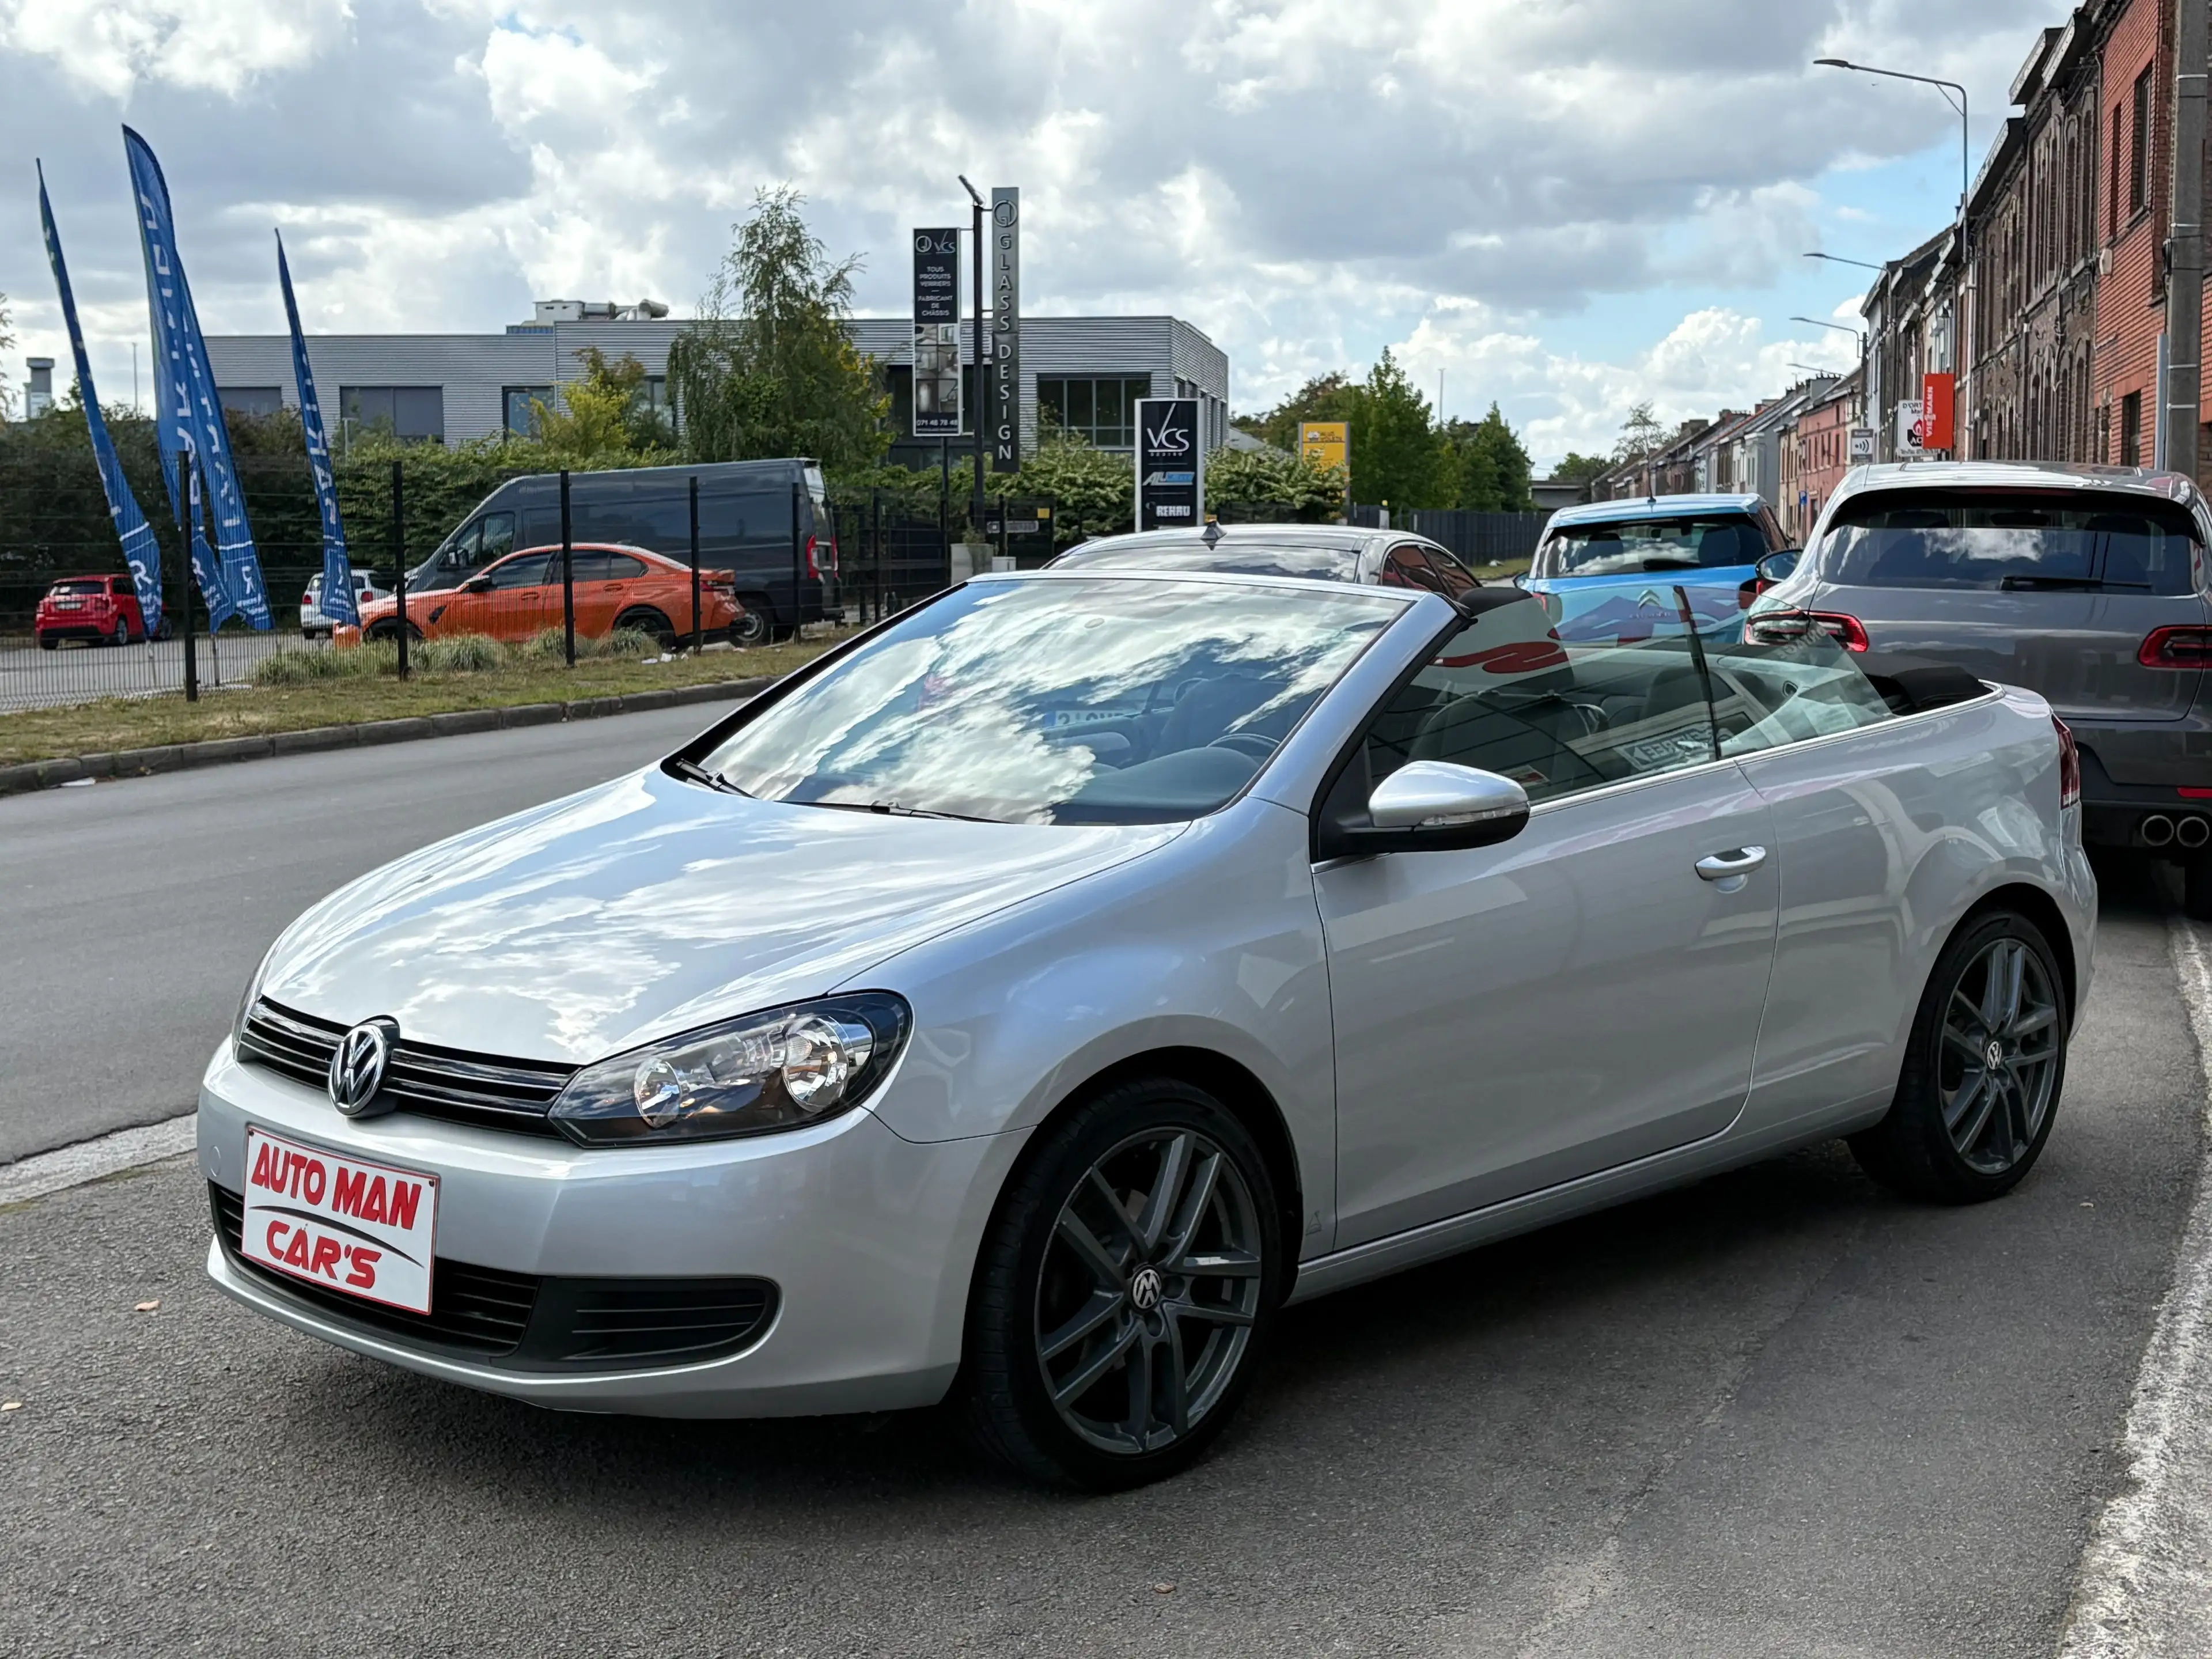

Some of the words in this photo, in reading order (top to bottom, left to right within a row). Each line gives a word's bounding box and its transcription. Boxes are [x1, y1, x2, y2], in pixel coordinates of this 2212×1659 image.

[998, 234, 1012, 332] GLASS
[998, 344, 1012, 460] DESIGN
[1146, 402, 1190, 452] VCS
[1156, 505, 1191, 517] REHAU
[251, 1142, 327, 1206] AUTO
[332, 1166, 422, 1230] MAN
[266, 1219, 382, 1289] CAR'S
